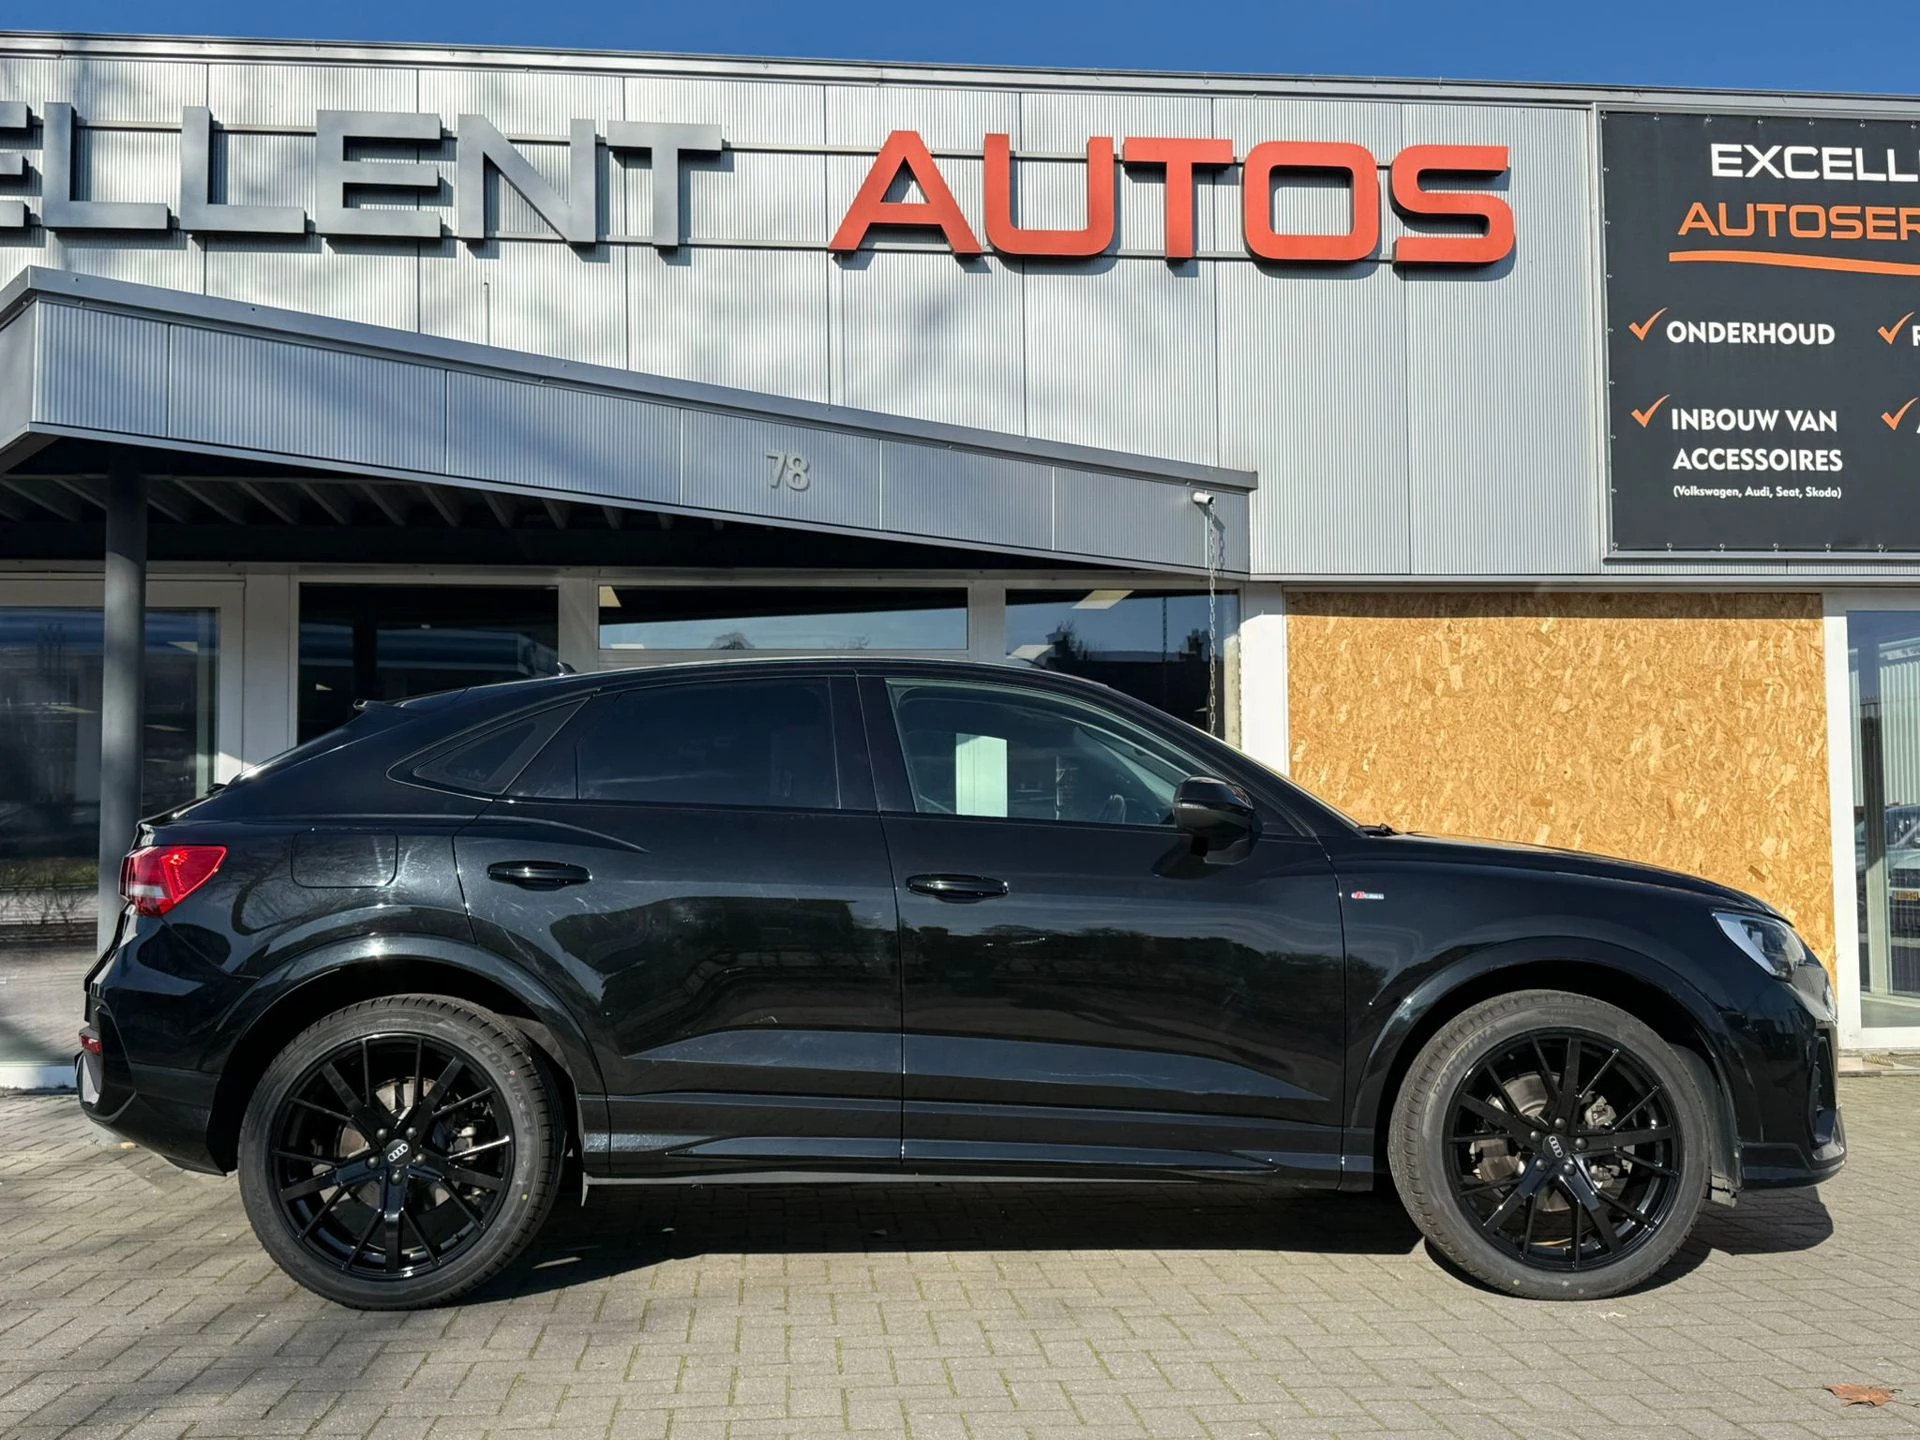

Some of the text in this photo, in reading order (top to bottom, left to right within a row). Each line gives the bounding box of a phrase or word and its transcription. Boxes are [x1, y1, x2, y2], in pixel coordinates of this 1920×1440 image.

[1710, 143, 1920, 182] EXCELL
[0, 101, 1515, 263] LLENT AUTOS
[1677, 202, 1920, 241] AUTOSER
[1666, 320, 1836, 345] ONDERHOUD
[1671, 408, 1838, 432] INBOUW VAN
[765, 451, 810, 492] 78
[1672, 447, 1843, 472] ACCESSOIRES
[1673, 485, 1842, 499] (Volkswagen, Audi, Seat, Skoda)
